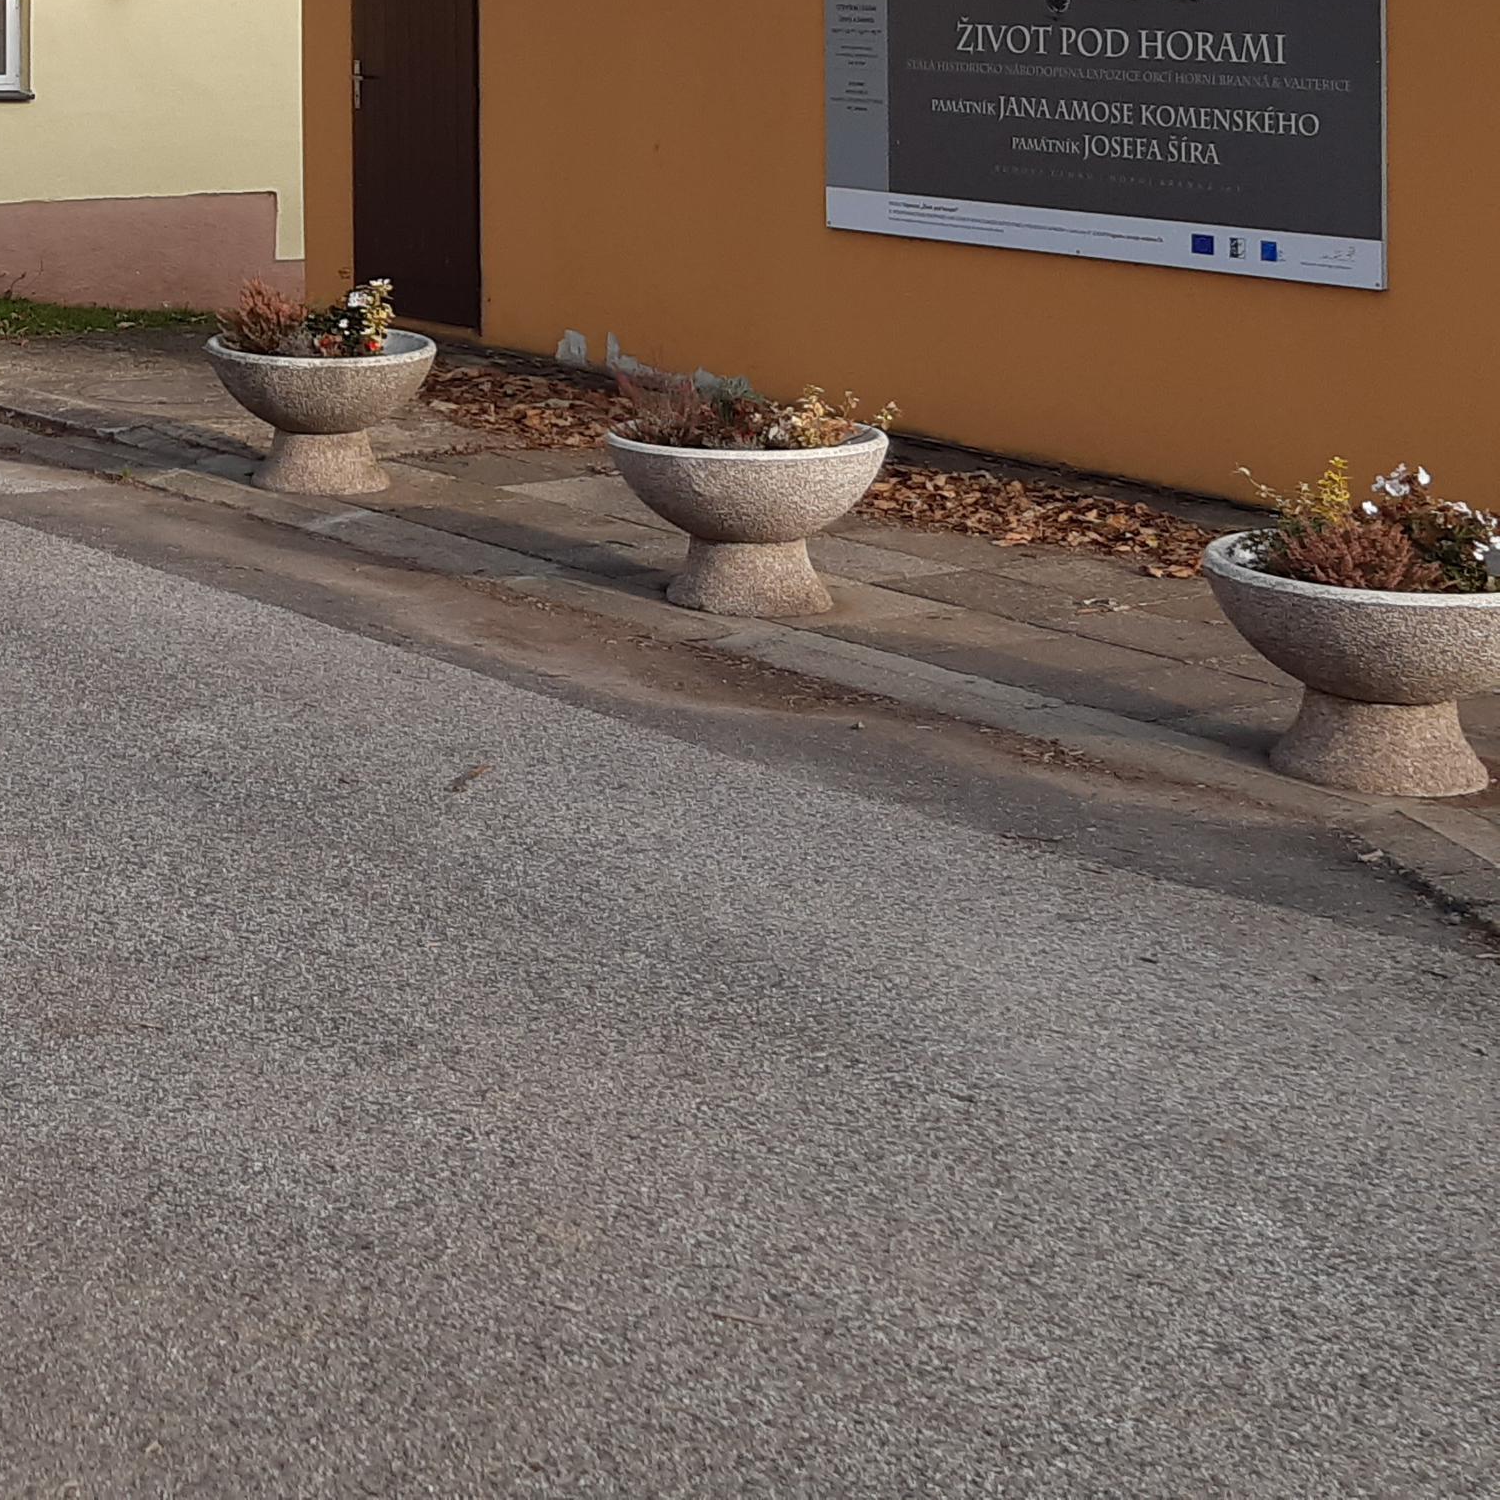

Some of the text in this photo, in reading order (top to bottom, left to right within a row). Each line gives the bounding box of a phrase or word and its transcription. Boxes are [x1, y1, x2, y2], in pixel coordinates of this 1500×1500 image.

[957, 16, 1287, 65] ŽIVOT POD HORAMI
[931, 95, 1320, 136] PAMÁTNÍK JANA AMOSE KOMENSKÉHO
[1011, 134, 1220, 165] PAMÁTNÍK JOSEFA ŠÍRA
